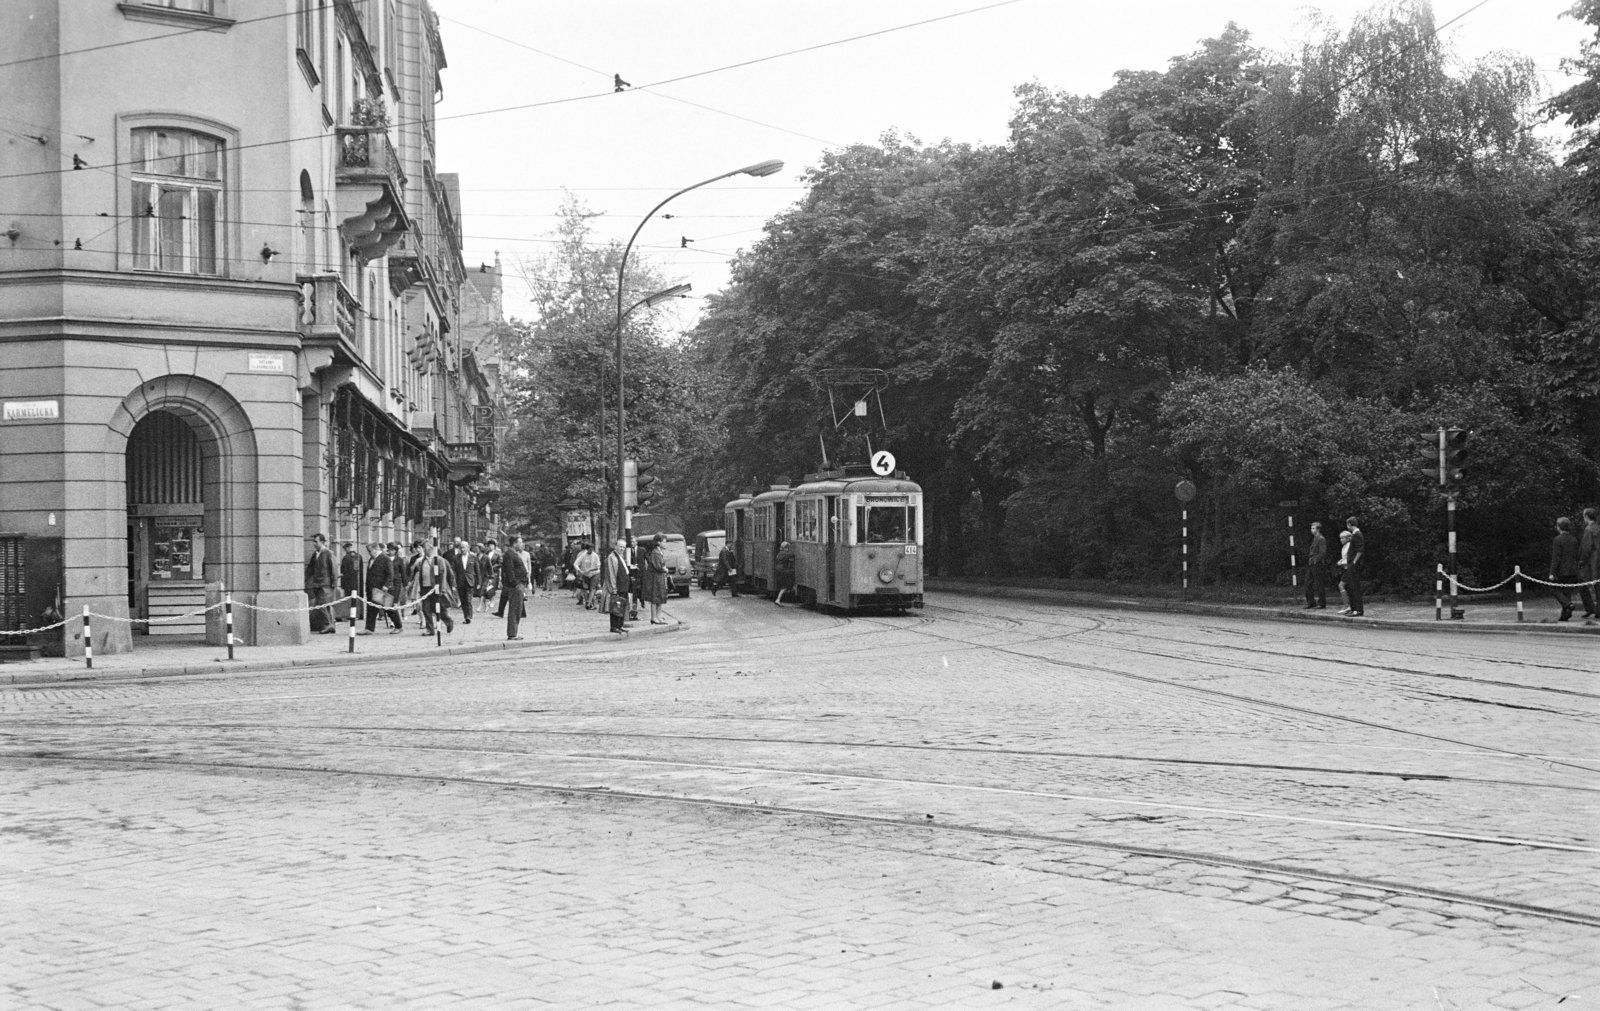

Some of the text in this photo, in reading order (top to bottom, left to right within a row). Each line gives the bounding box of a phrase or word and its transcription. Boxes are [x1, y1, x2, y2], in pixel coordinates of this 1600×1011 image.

[6, 407, 54, 417] KARMELICKA
[475, 406, 494, 462] PZU
[877, 455, 889, 471] 4
